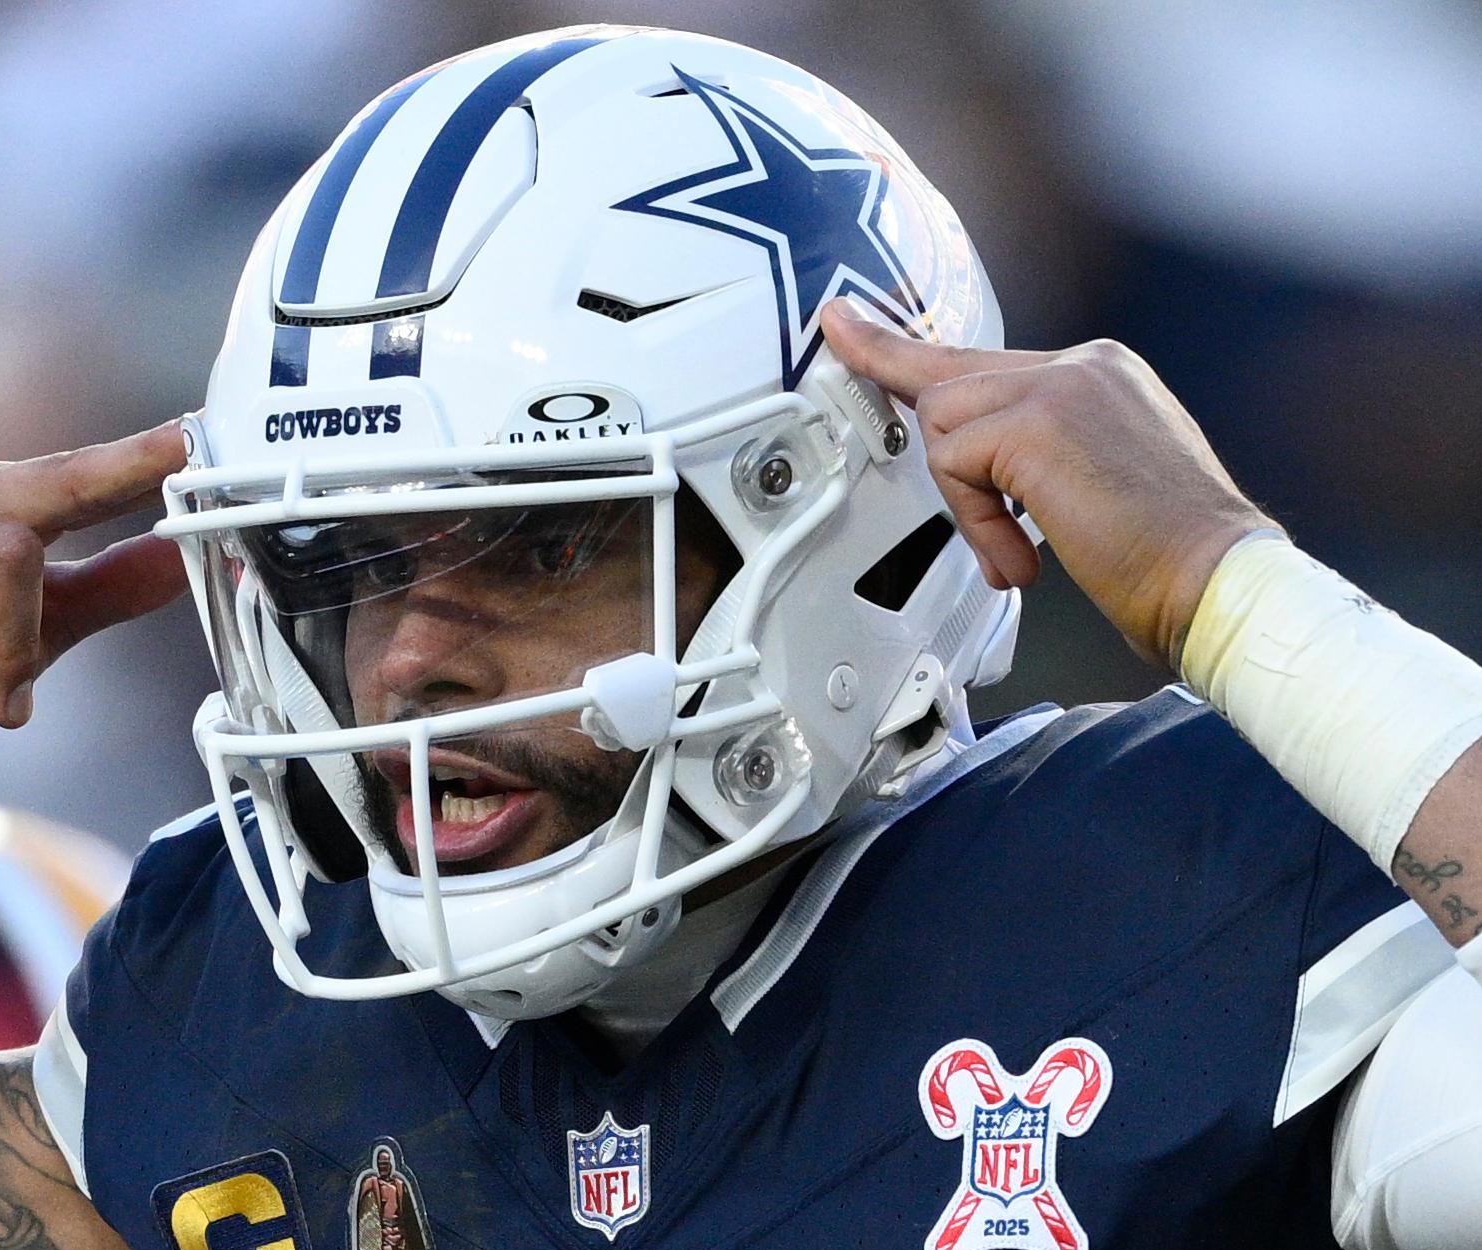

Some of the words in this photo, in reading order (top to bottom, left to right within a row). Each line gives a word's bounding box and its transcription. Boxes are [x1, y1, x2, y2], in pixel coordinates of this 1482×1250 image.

[266, 404, 402, 443] COWBOYS
[509, 422, 631, 444] OAKLEY
[976, 1142, 1039, 1194] NFL
[581, 1170, 637, 1218] NFL
[983, 1218, 1031, 1237] 2025
